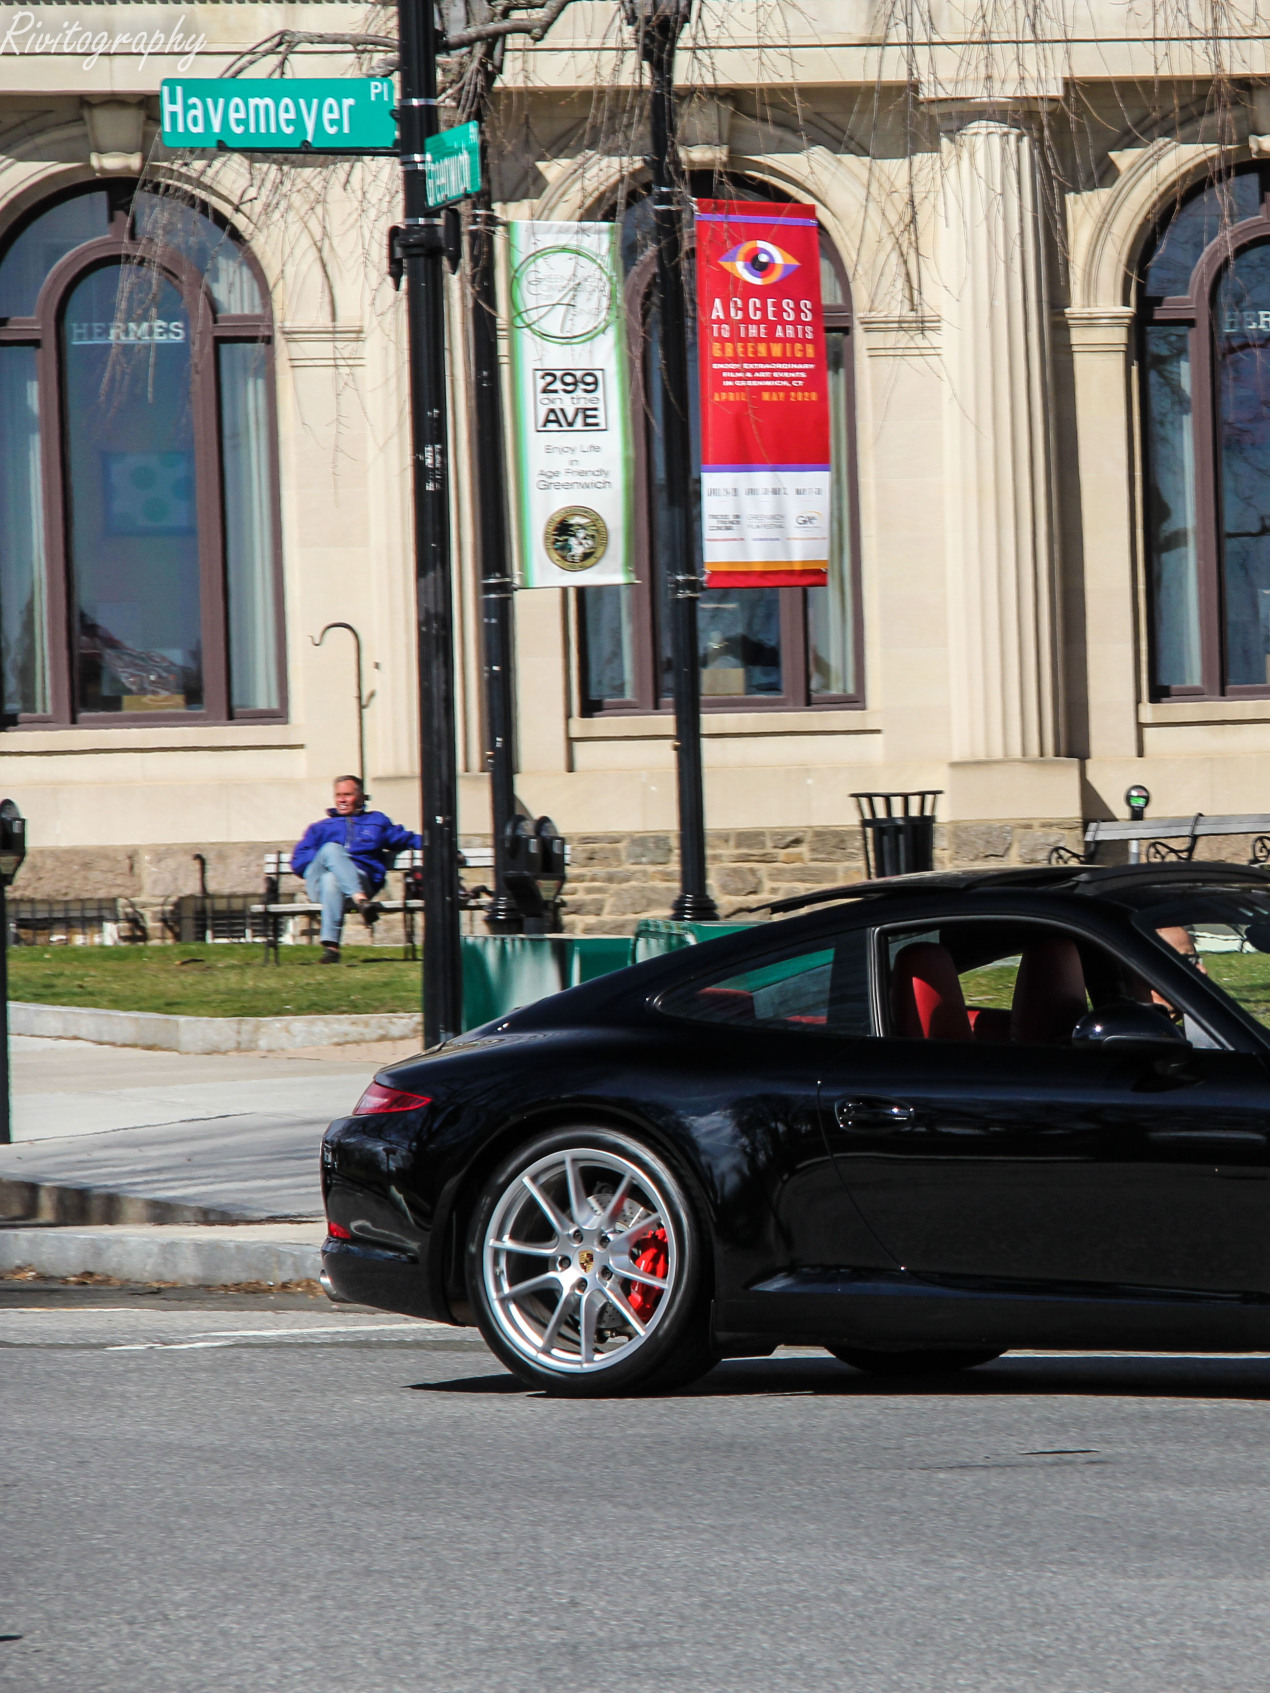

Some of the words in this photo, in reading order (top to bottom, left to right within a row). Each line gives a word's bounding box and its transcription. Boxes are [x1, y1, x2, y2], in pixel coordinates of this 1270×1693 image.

[161, 85, 356, 142] Havemeyer
[370, 81, 389, 101] Pl
[711, 298, 812, 321] ACCESS
[711, 324, 730, 338] TO
[738, 324, 768, 338] THE
[775, 324, 814, 339] ARTS
[712, 342, 815, 358] GREENWICH
[539, 372, 598, 394] 299
[539, 396, 562, 405] on
[570, 396, 600, 405] the
[713, 391, 747, 401] APRIL
[761, 391, 785, 401] MAY
[541, 407, 599, 427] AVE
[544, 444, 576, 455] Enjoy
[538, 469, 560, 479] Age
[564, 467, 609, 478] Friendly
[536, 479, 612, 491] Greenwich
